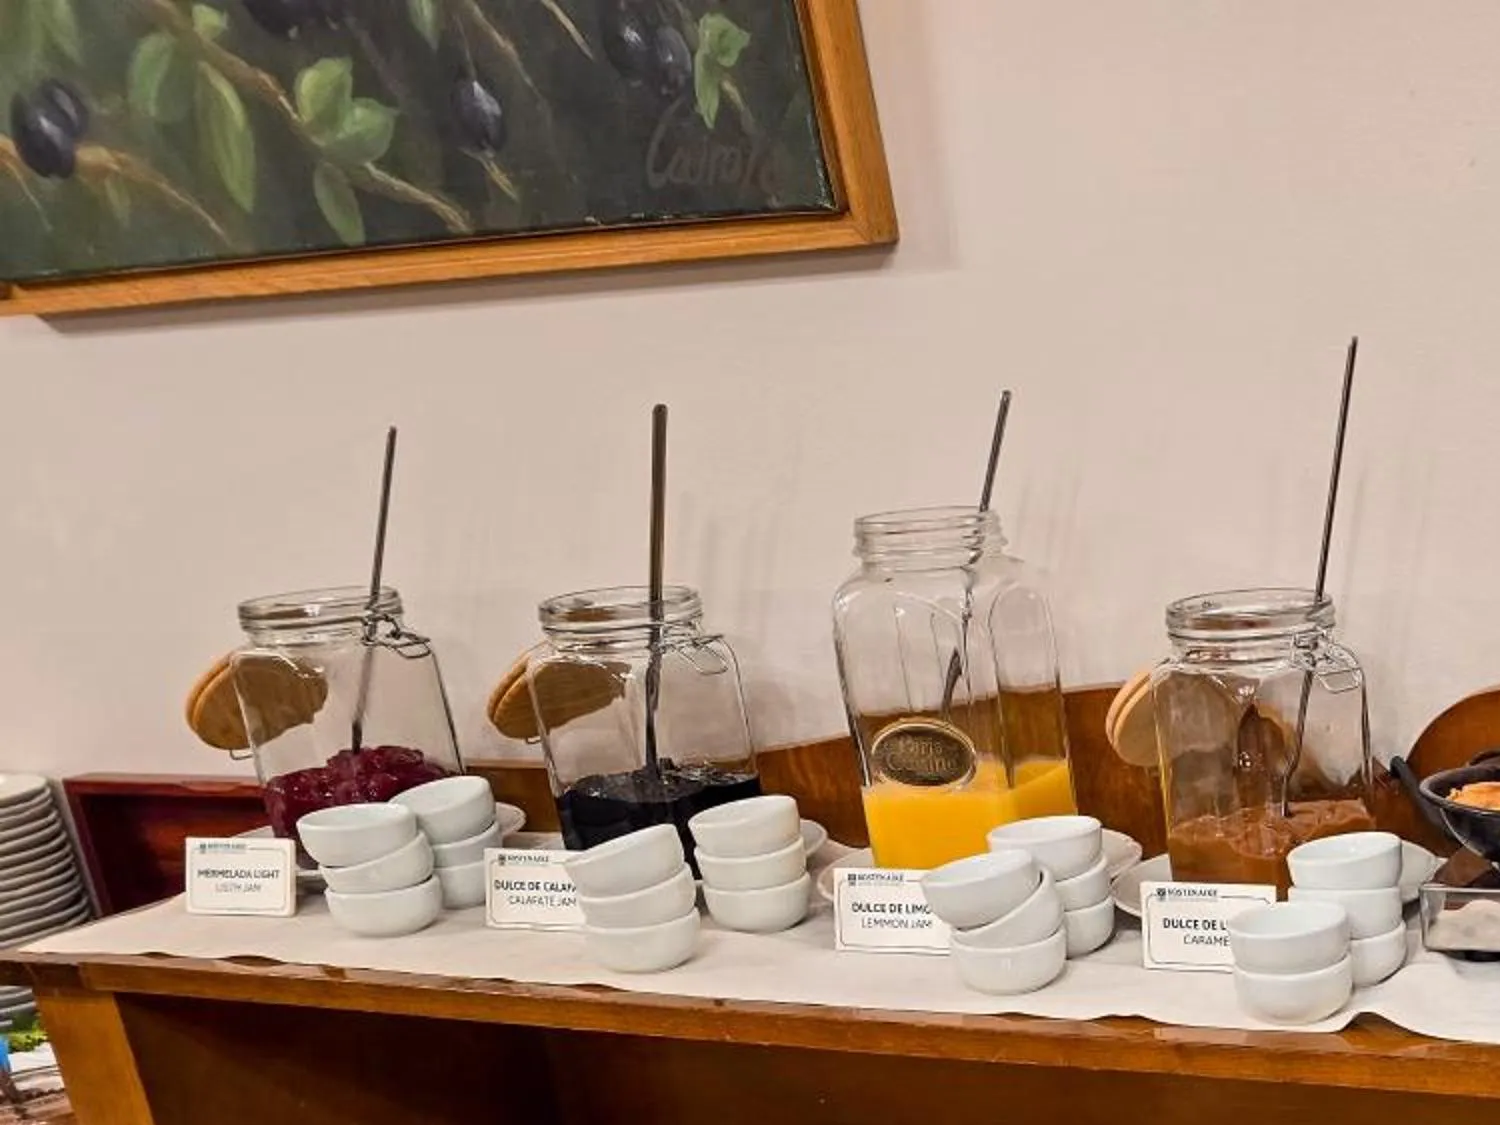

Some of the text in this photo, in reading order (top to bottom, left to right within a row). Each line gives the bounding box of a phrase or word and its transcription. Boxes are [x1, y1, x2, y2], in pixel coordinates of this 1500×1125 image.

[253, 869, 280, 879] LIGHT
[494, 879, 525, 891] DULCE
[851, 902, 887, 913] DULCE
[889, 903, 903, 914] DE
[861, 917, 909, 929] LEMMON
[1162, 917, 1199, 930] DULCE
[1201, 919, 1218, 931] DE
[1183, 934, 1230, 947] CARAME
